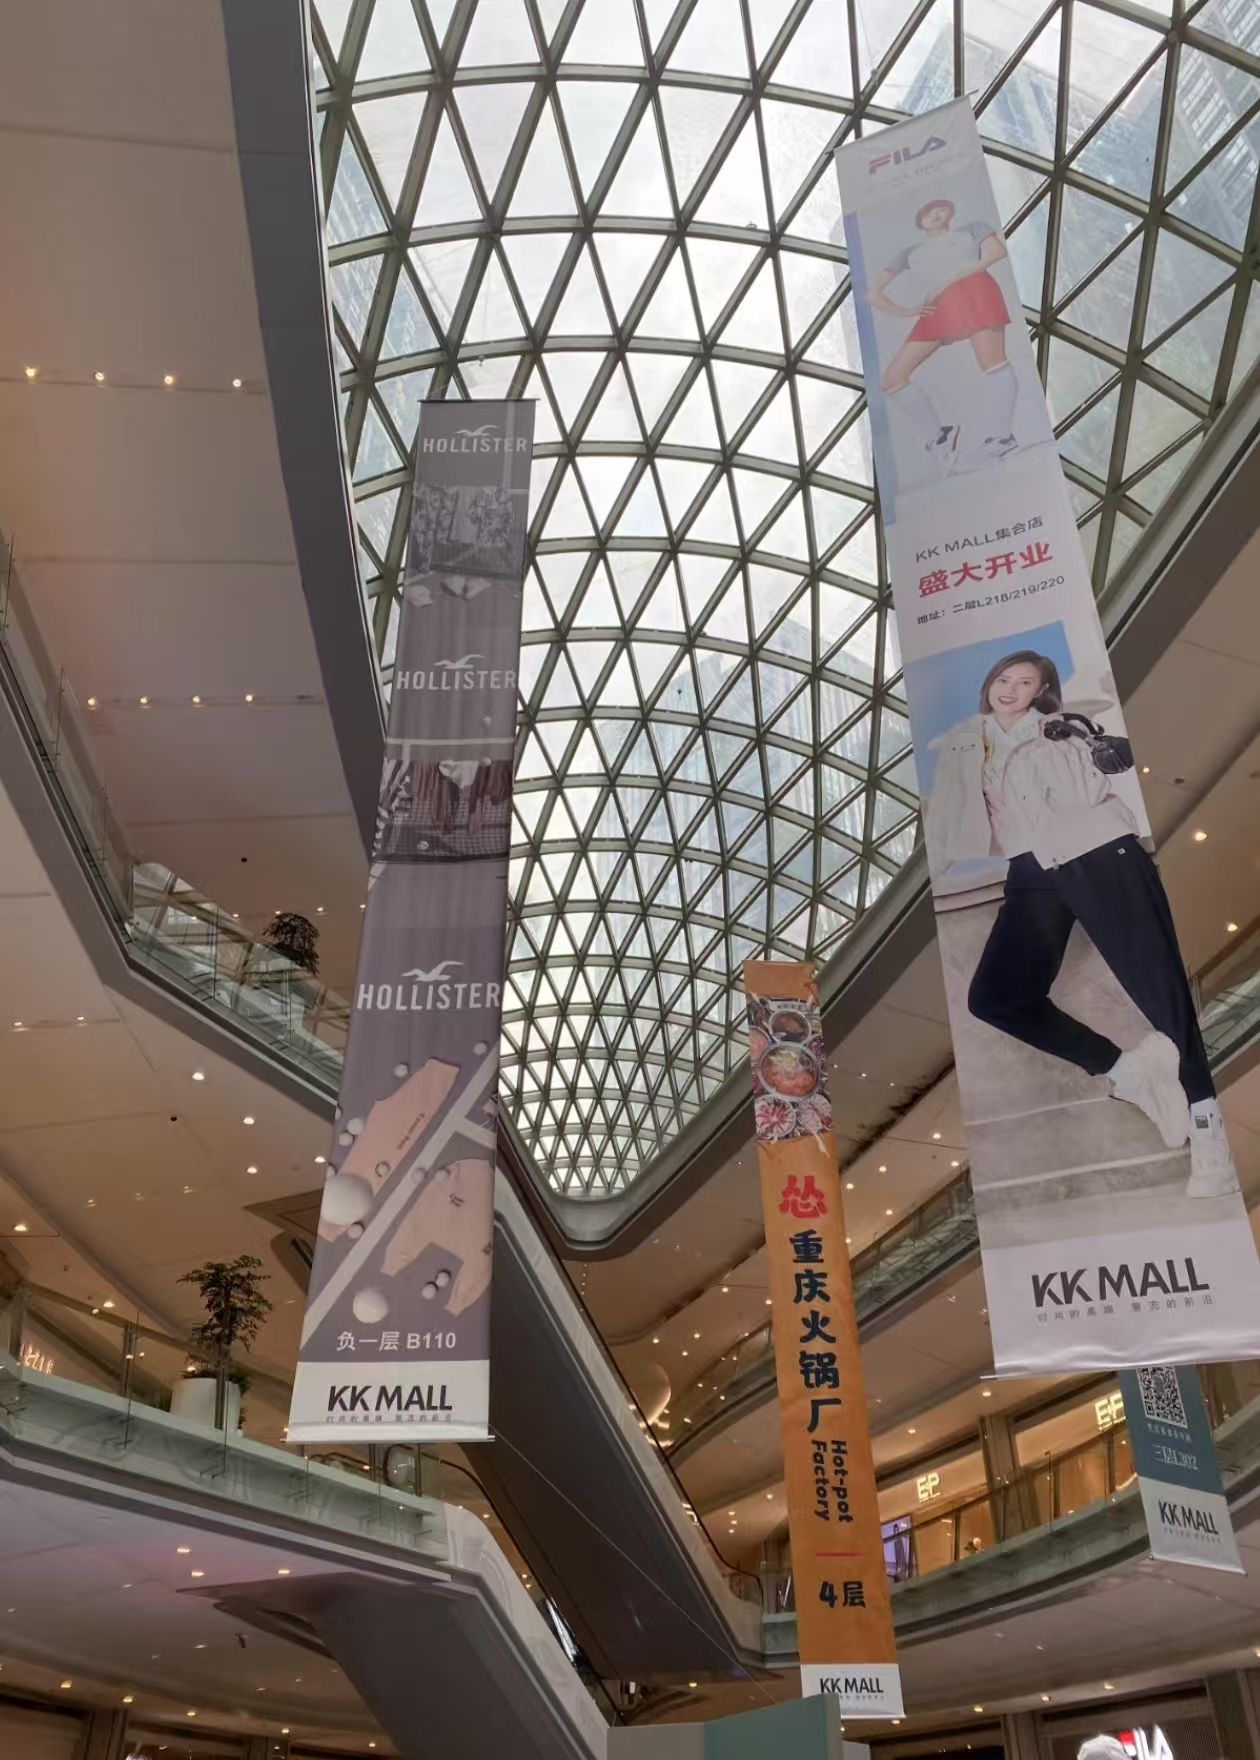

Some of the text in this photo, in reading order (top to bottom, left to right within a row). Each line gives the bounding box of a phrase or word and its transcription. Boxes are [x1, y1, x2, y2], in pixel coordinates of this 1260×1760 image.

[868, 136, 947, 175] FILA
[422, 437, 528, 453] HOLLISTER
[915, 546, 940, 563] KK
[918, 541, 1054, 598] 盛大开业
[396, 670, 517, 690] HOLLISTER
[356, 982, 501, 1011] HOLLISTER
[778, 1174, 829, 1219] 怂
[336, 1331, 457, 1351] 负一层 B110
[789, 1228, 842, 1433] 重庆火锅厂
[812, 1439, 830, 1521] Factory
[831, 1440, 853, 1524] Hot-pot
[916, 1471, 940, 1500] EP
